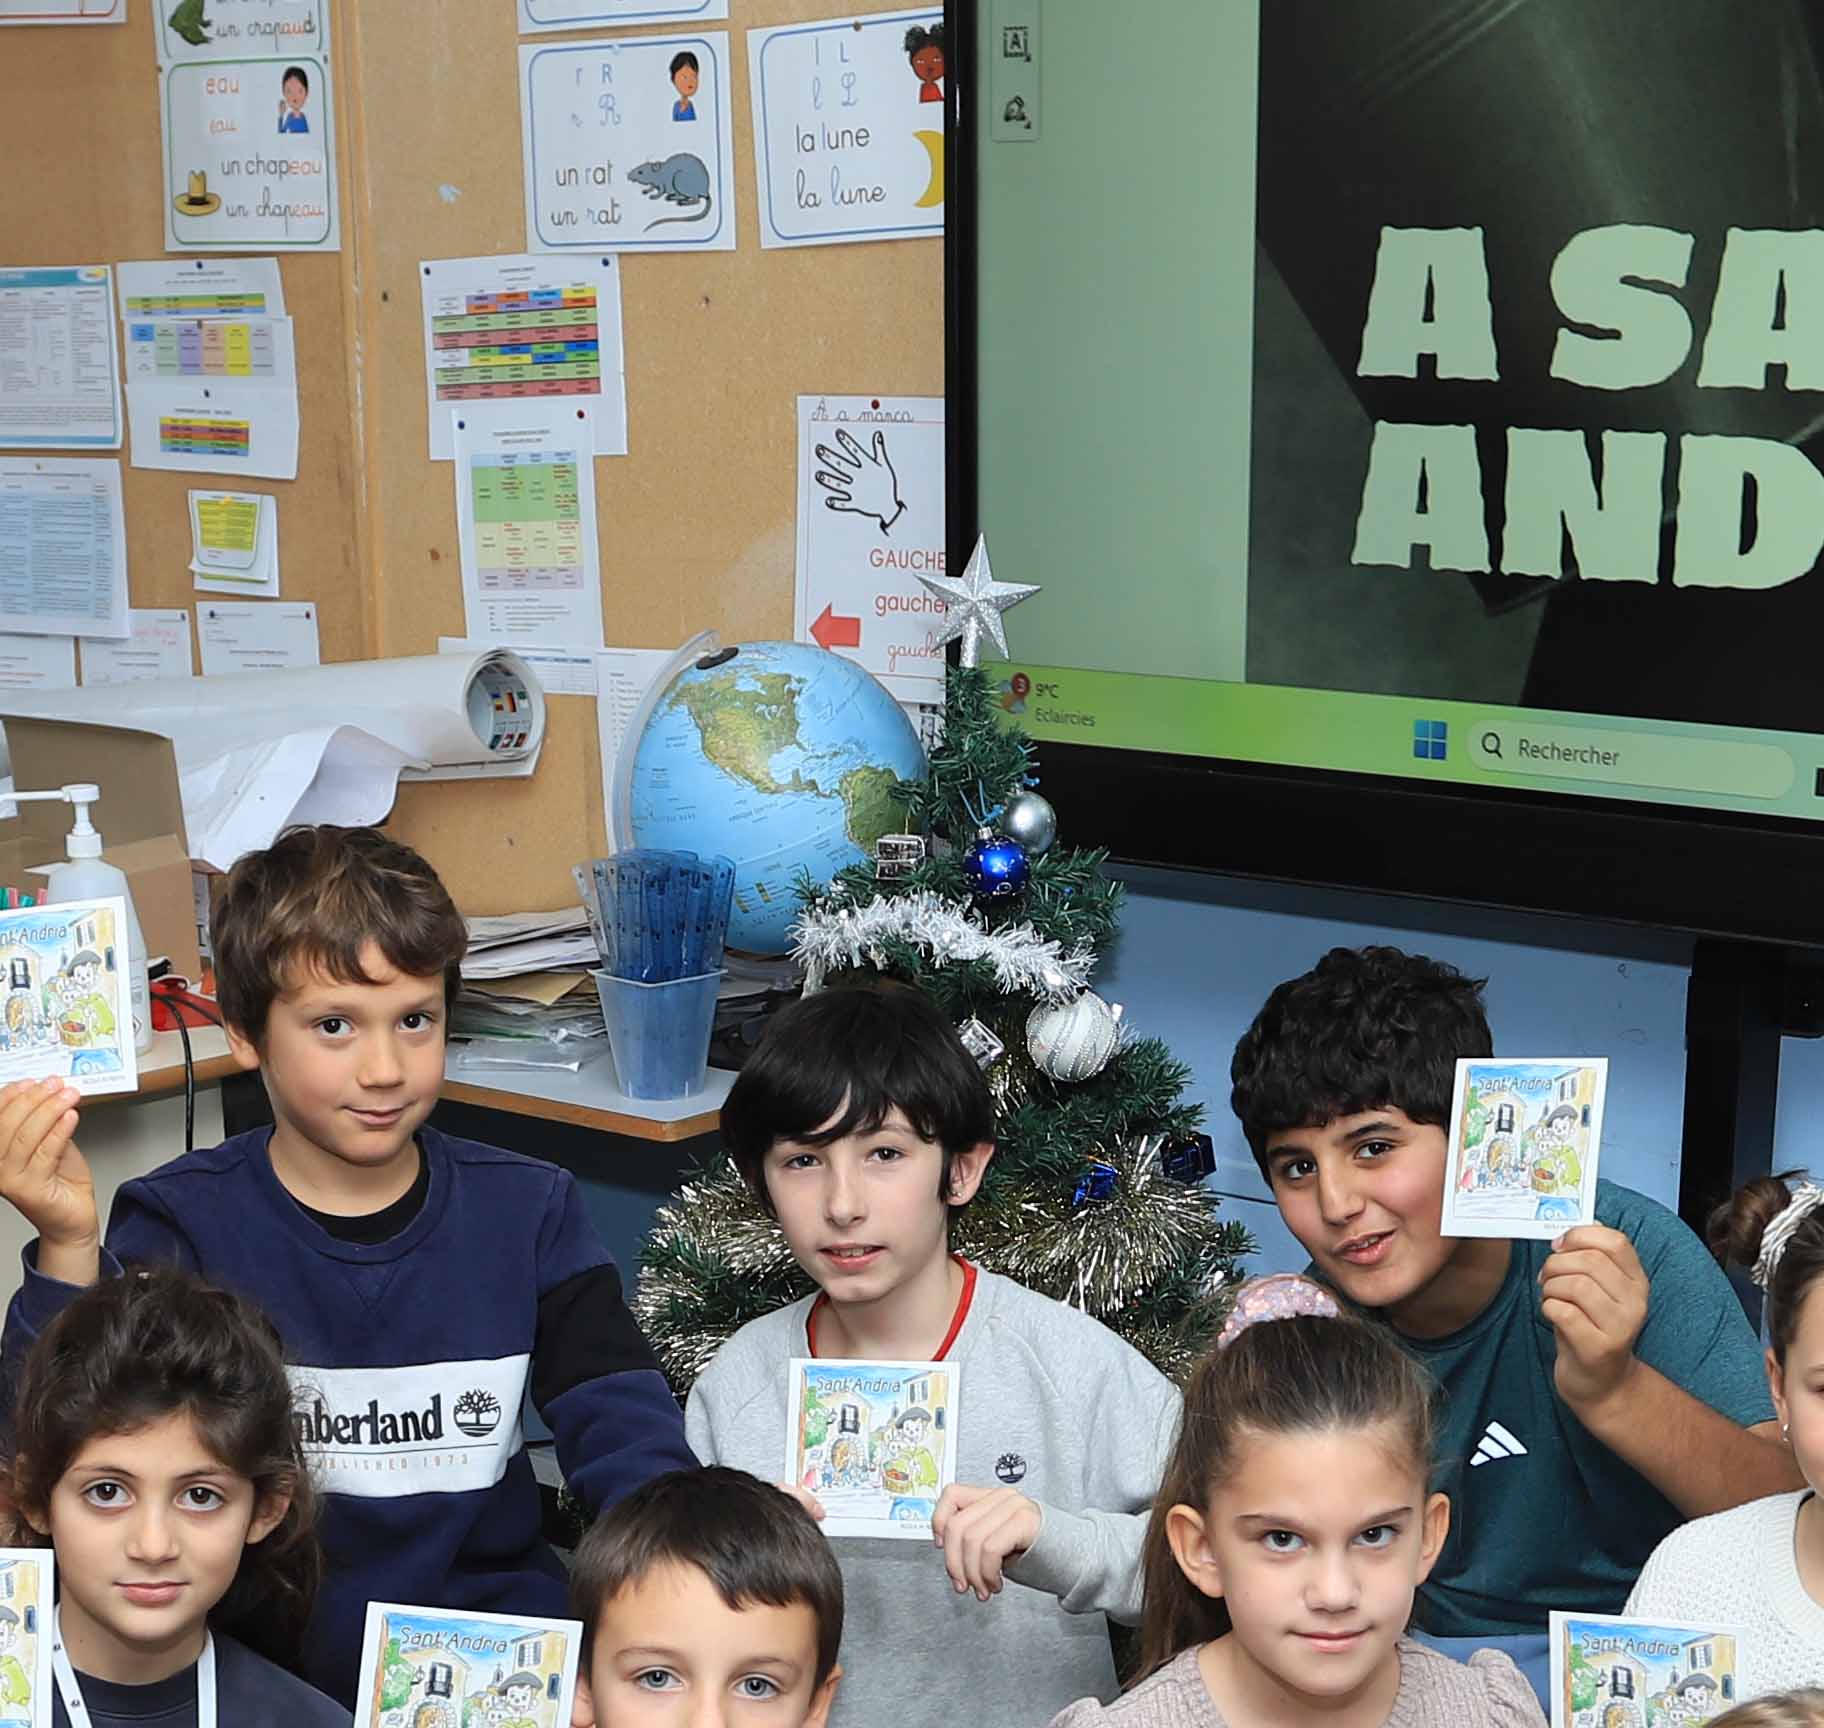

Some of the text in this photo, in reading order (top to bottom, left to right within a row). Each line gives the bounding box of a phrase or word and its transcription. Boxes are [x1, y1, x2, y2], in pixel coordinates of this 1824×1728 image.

[205, 77, 240, 96] eau
[601, 64, 613, 84] R
[795, 122, 872, 154] la lune
[221, 152, 323, 181] un chapeau
[555, 160, 614, 187] un rat
[795, 164, 887, 209] la lune
[226, 187, 325, 236] un chapeau
[550, 197, 622, 227] un rat
[1355, 226, 1500, 382] A
[870, 548, 946, 571] GAUCHE
[875, 590, 945, 617] gauche
[1518, 738, 1620, 767] Rechercher
